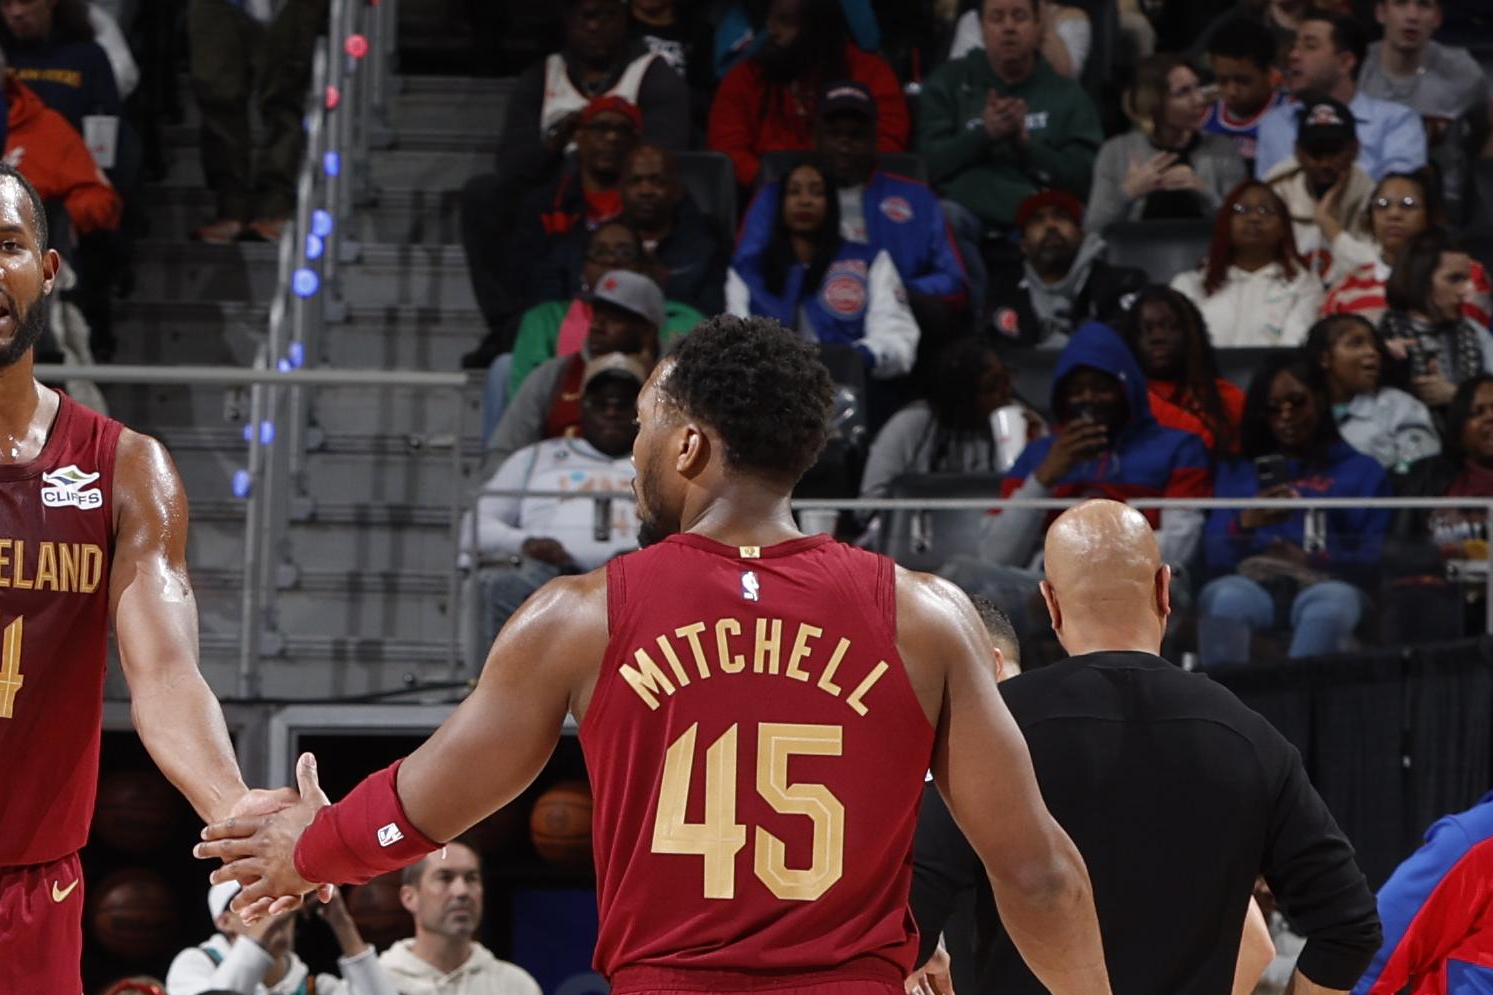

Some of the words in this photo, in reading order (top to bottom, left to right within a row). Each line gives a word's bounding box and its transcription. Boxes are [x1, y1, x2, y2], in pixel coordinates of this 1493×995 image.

[44, 490, 101, 506] CLIFFS
[618, 617, 889, 717] MITCHELL
[651, 721, 846, 902] 45
